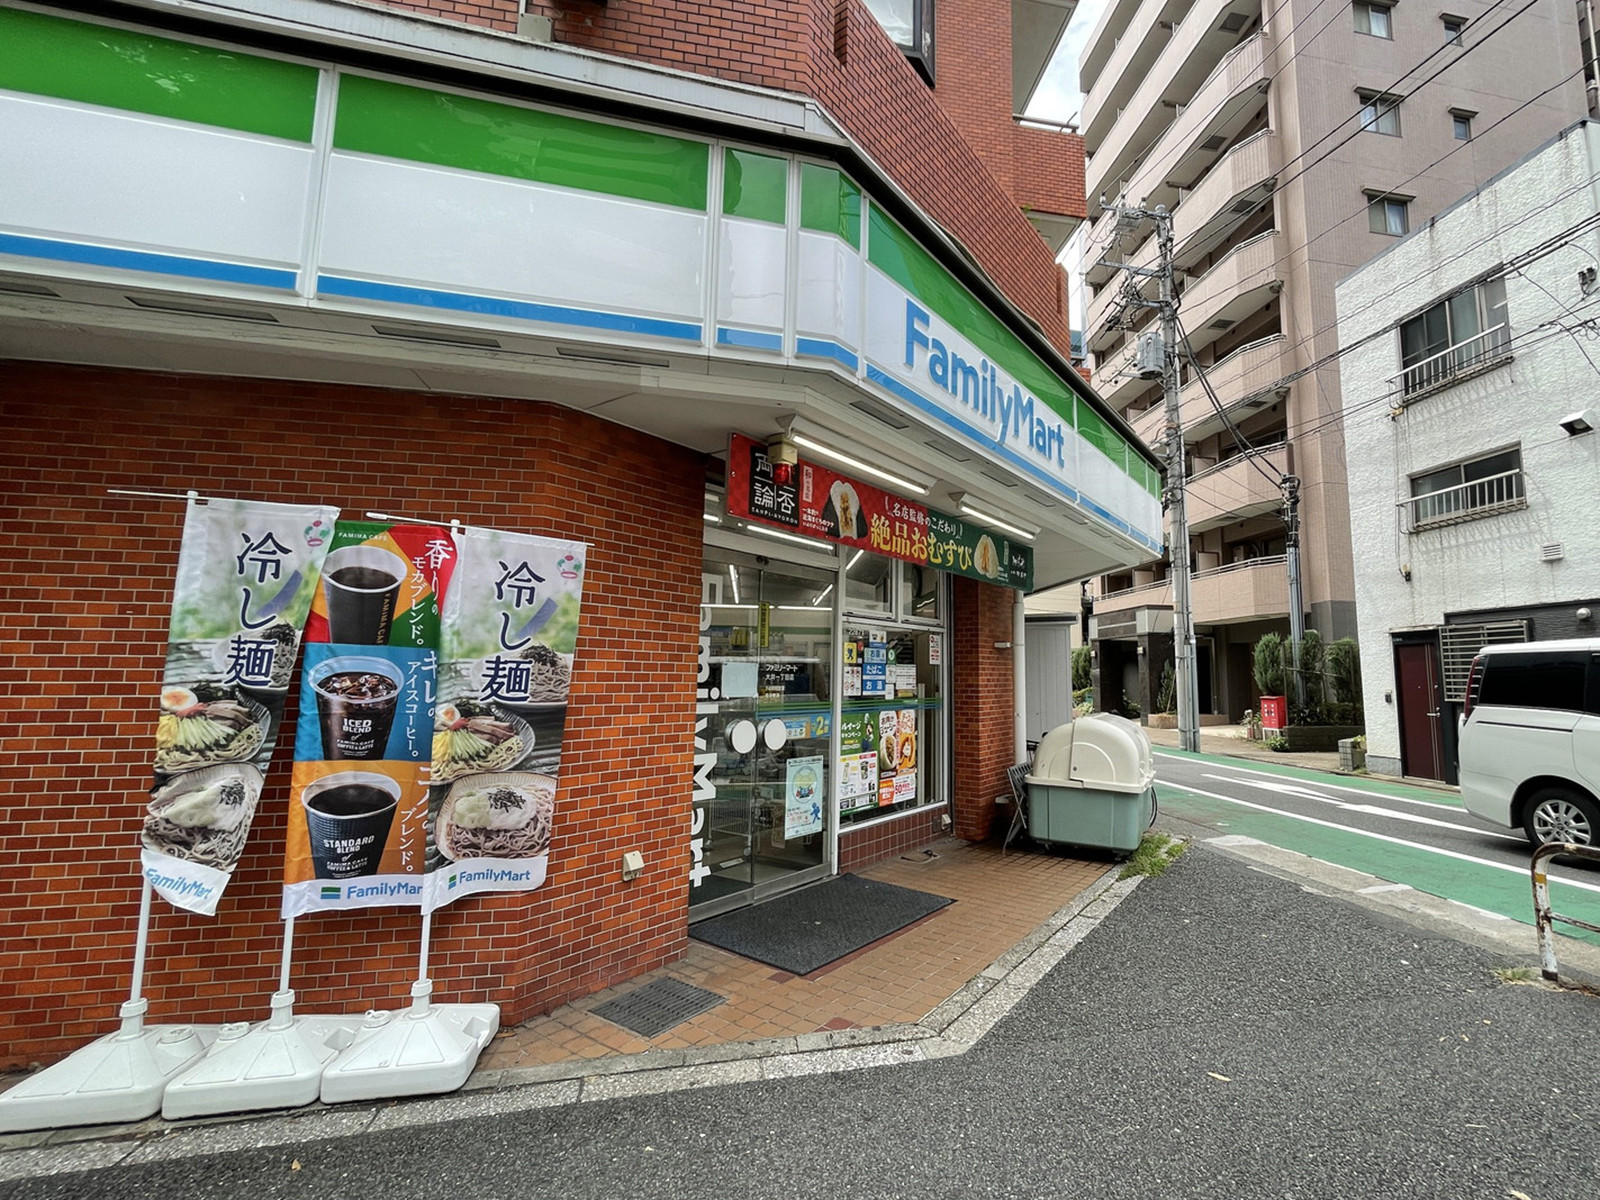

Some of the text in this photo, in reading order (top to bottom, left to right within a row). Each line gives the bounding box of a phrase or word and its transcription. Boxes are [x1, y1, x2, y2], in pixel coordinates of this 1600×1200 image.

[905, 297, 1065, 469] FamilyMart
[892, 502, 957, 536] 名店監修のこだわり
[338, 532, 367, 540] FAMIMA
[870, 513, 973, 571] 絶品おむすび
[424, 539, 453, 616] 香りの
[223, 531, 294, 688] 冷し麺
[409, 556, 427, 645] モカブレンド。
[480, 560, 546, 703] 冷し麺
[765, 664, 798, 672] ファミリーマート
[866, 665, 882, 675] たばこ
[343, 718, 372, 728] ICED
[405, 661, 421, 758] アイスコーヒー。
[342, 725, 372, 734] BLEND
[323, 835, 375, 848] STANDARD
[336, 845, 361, 854] BLEND
[399, 807, 417, 872] ブレンド。
[146, 868, 214, 899] FamilyMart
[347, 882, 422, 899] FamilyMar
[458, 868, 530, 884] FamilyMart
